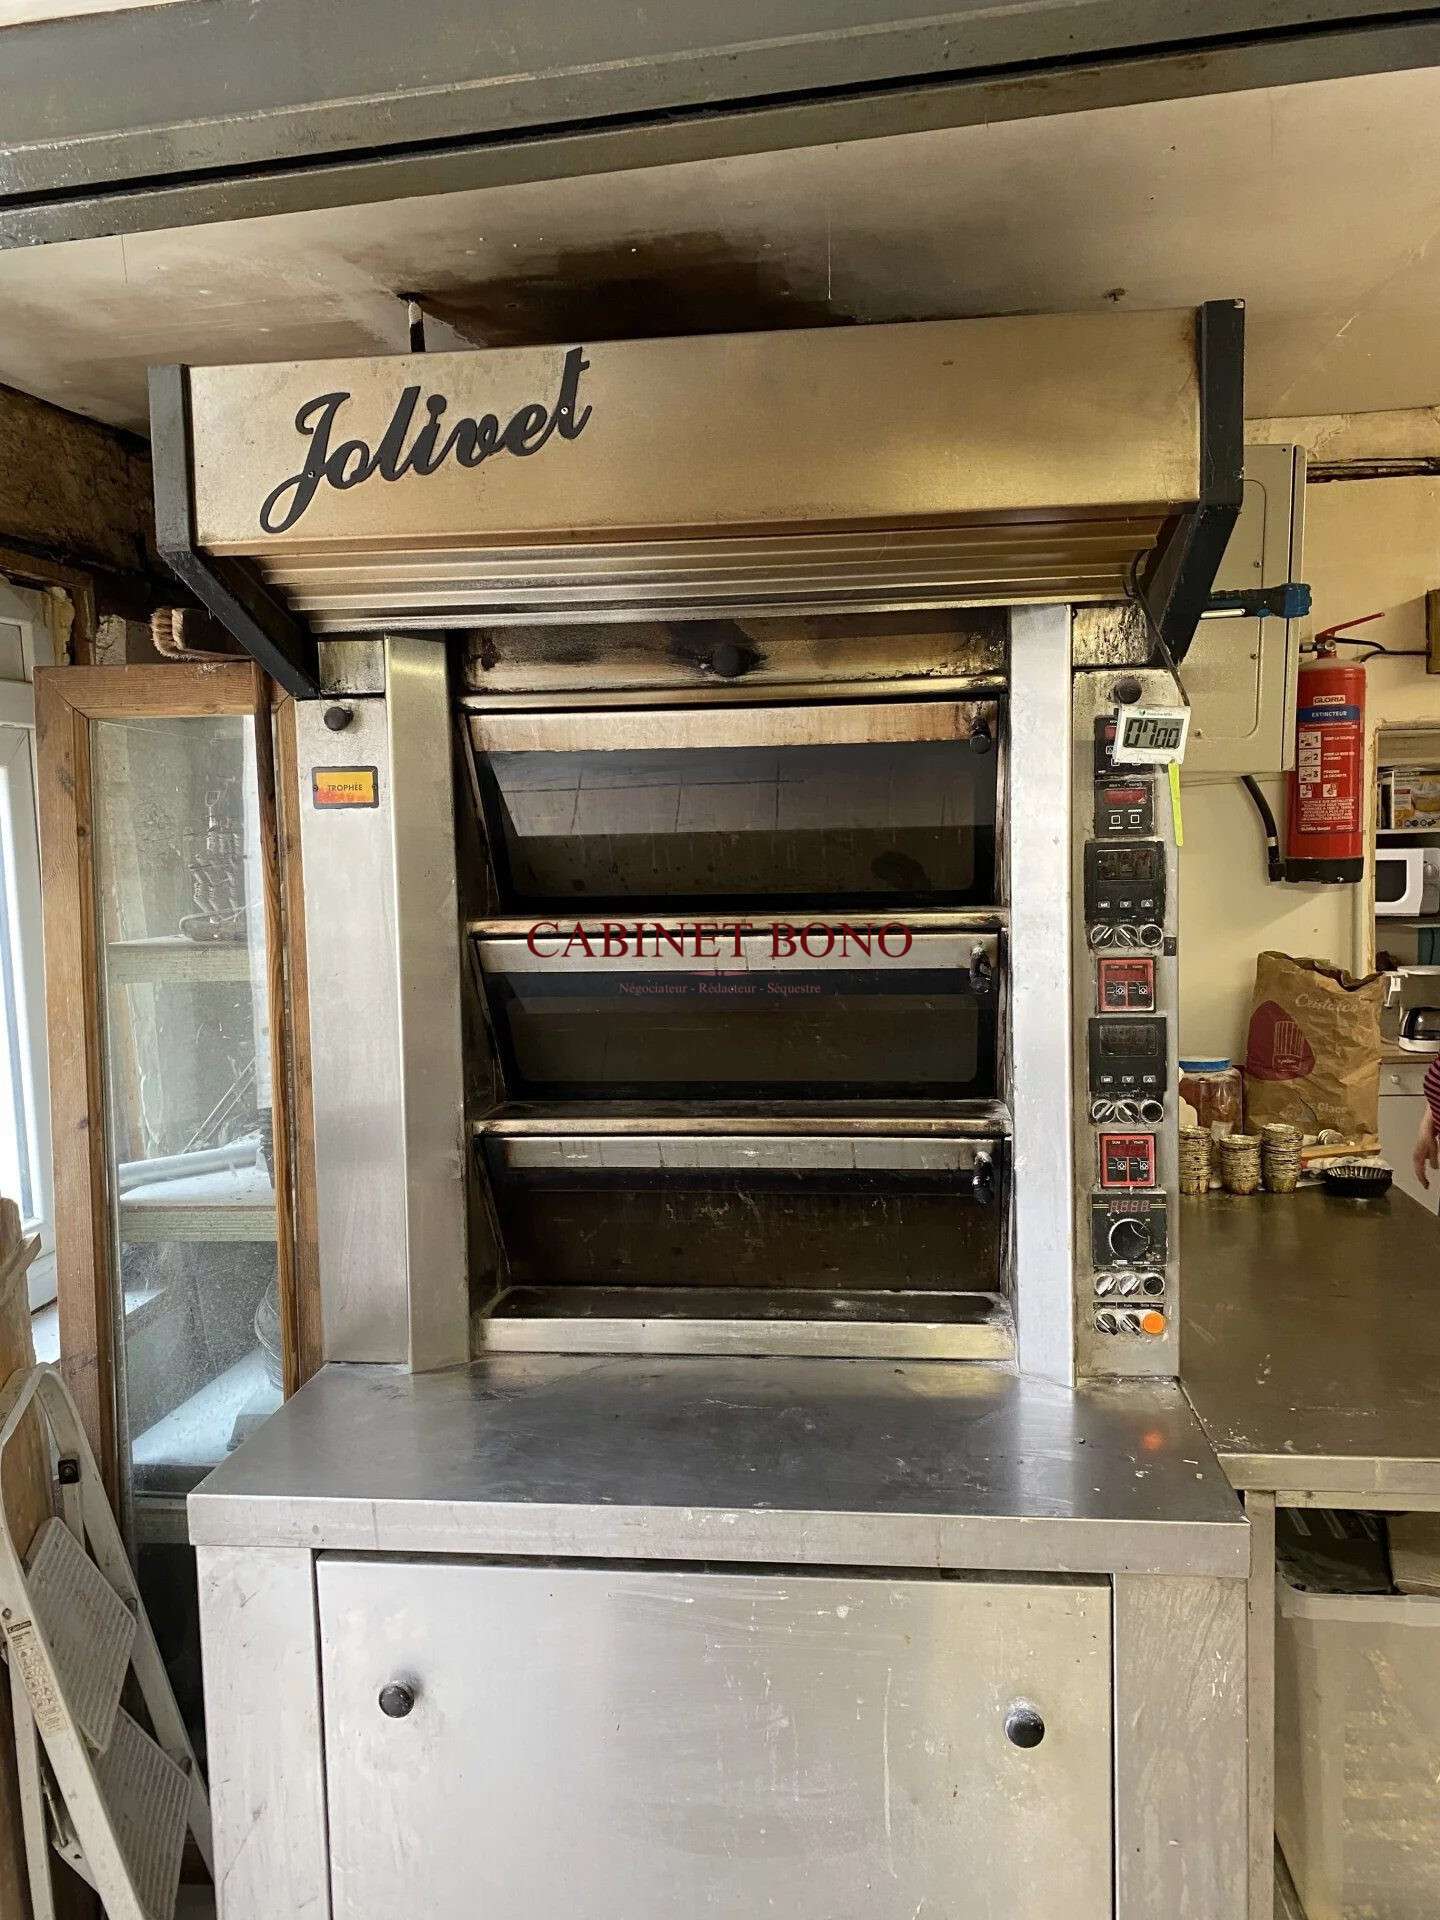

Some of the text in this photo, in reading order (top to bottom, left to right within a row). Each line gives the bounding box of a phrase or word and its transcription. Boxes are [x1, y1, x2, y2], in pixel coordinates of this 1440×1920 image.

[260, 346, 592, 534] Jolivet
[1314, 696, 1345, 704] GLORIA
[1313, 753, 1319, 761] 2
[1313, 770, 1319, 778] 3
